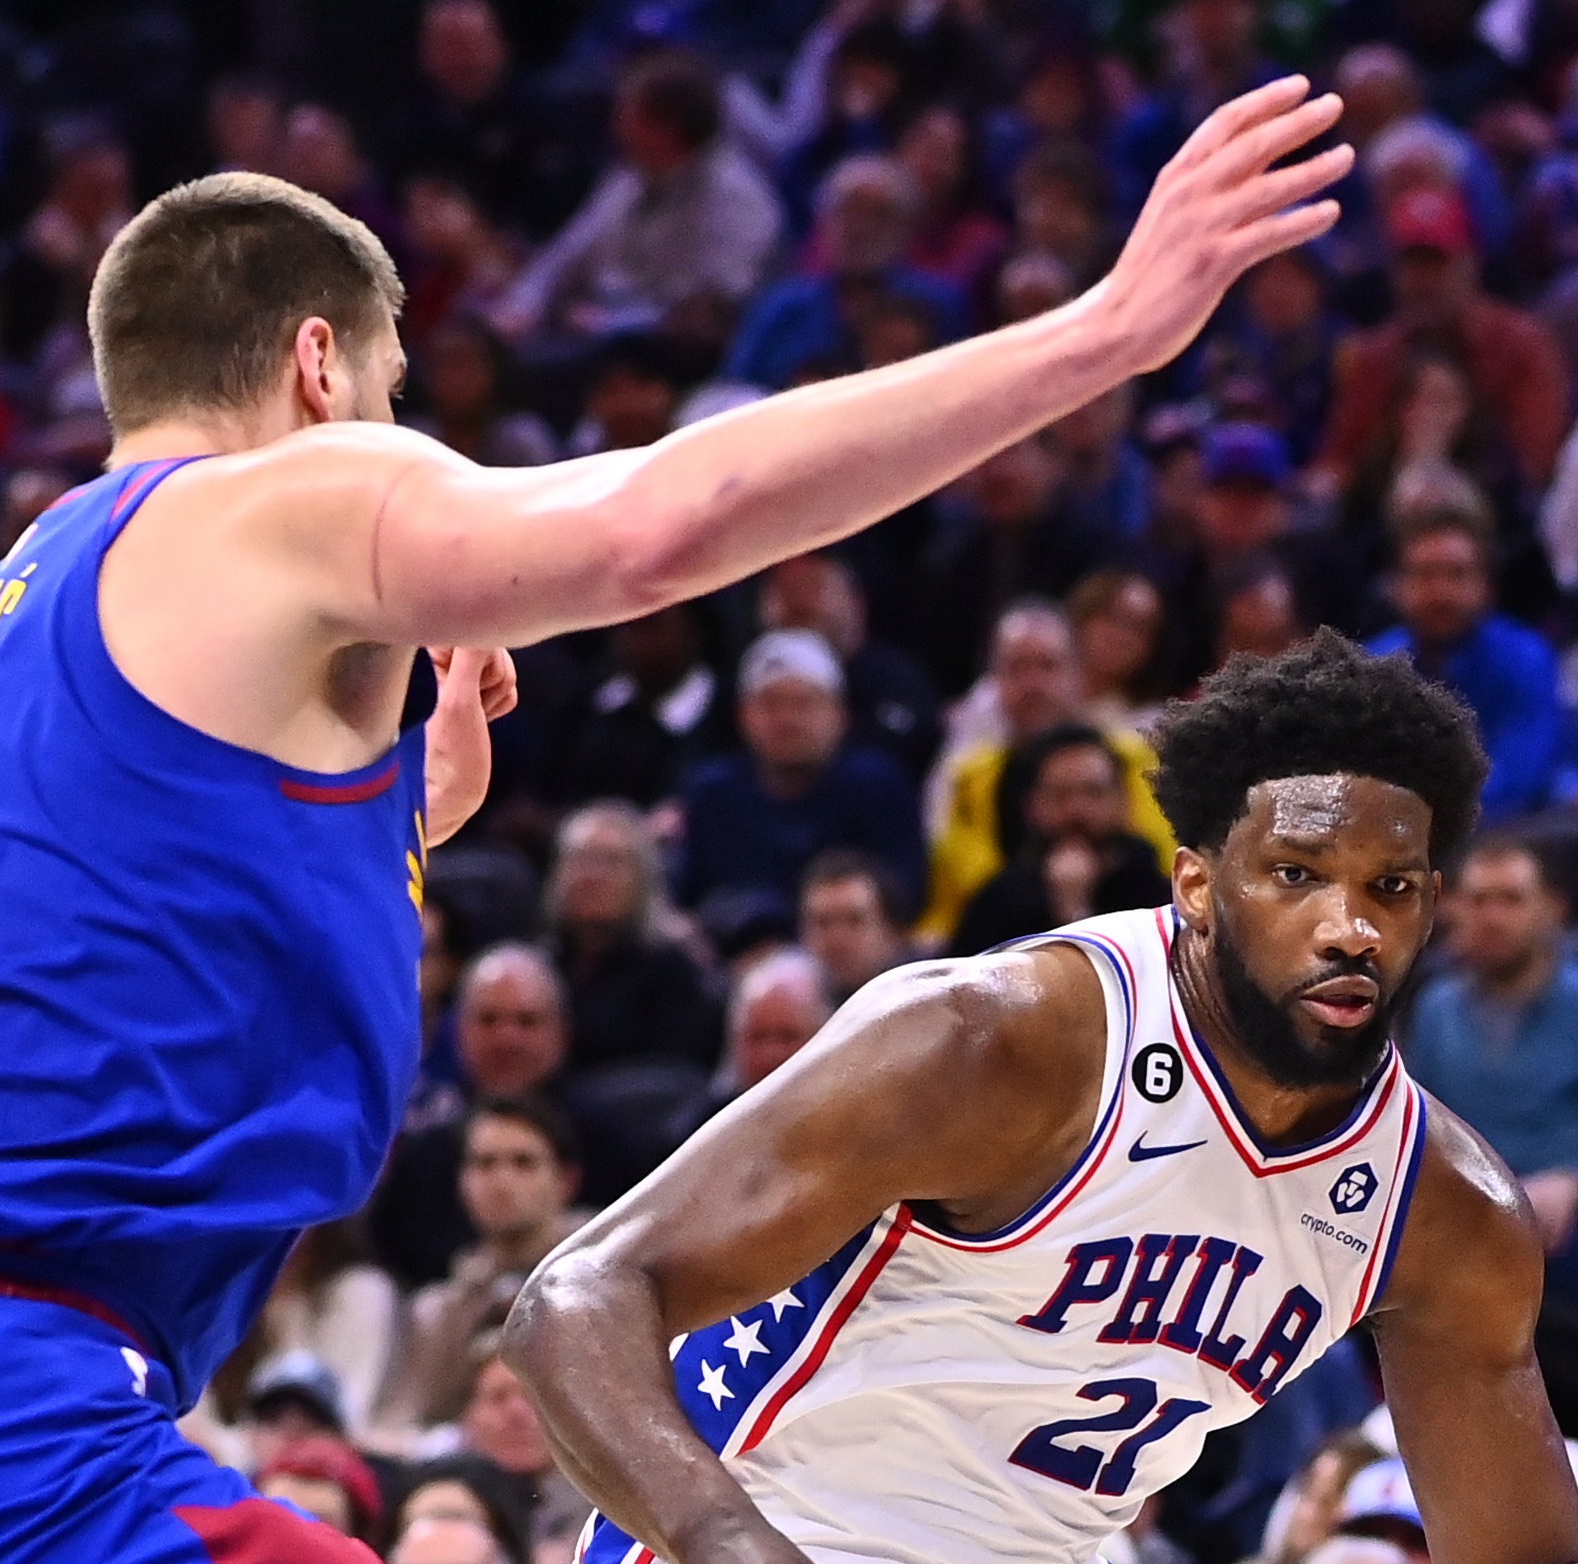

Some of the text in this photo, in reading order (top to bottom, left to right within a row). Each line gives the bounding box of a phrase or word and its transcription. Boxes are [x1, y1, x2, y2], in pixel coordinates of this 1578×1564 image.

[1145, 1051, 1173, 1096] 6
[1300, 1213, 1369, 1255] crypto.com
[1015, 1233, 1322, 1405] PHILA
[1007, 1377, 1212, 1497] 21
